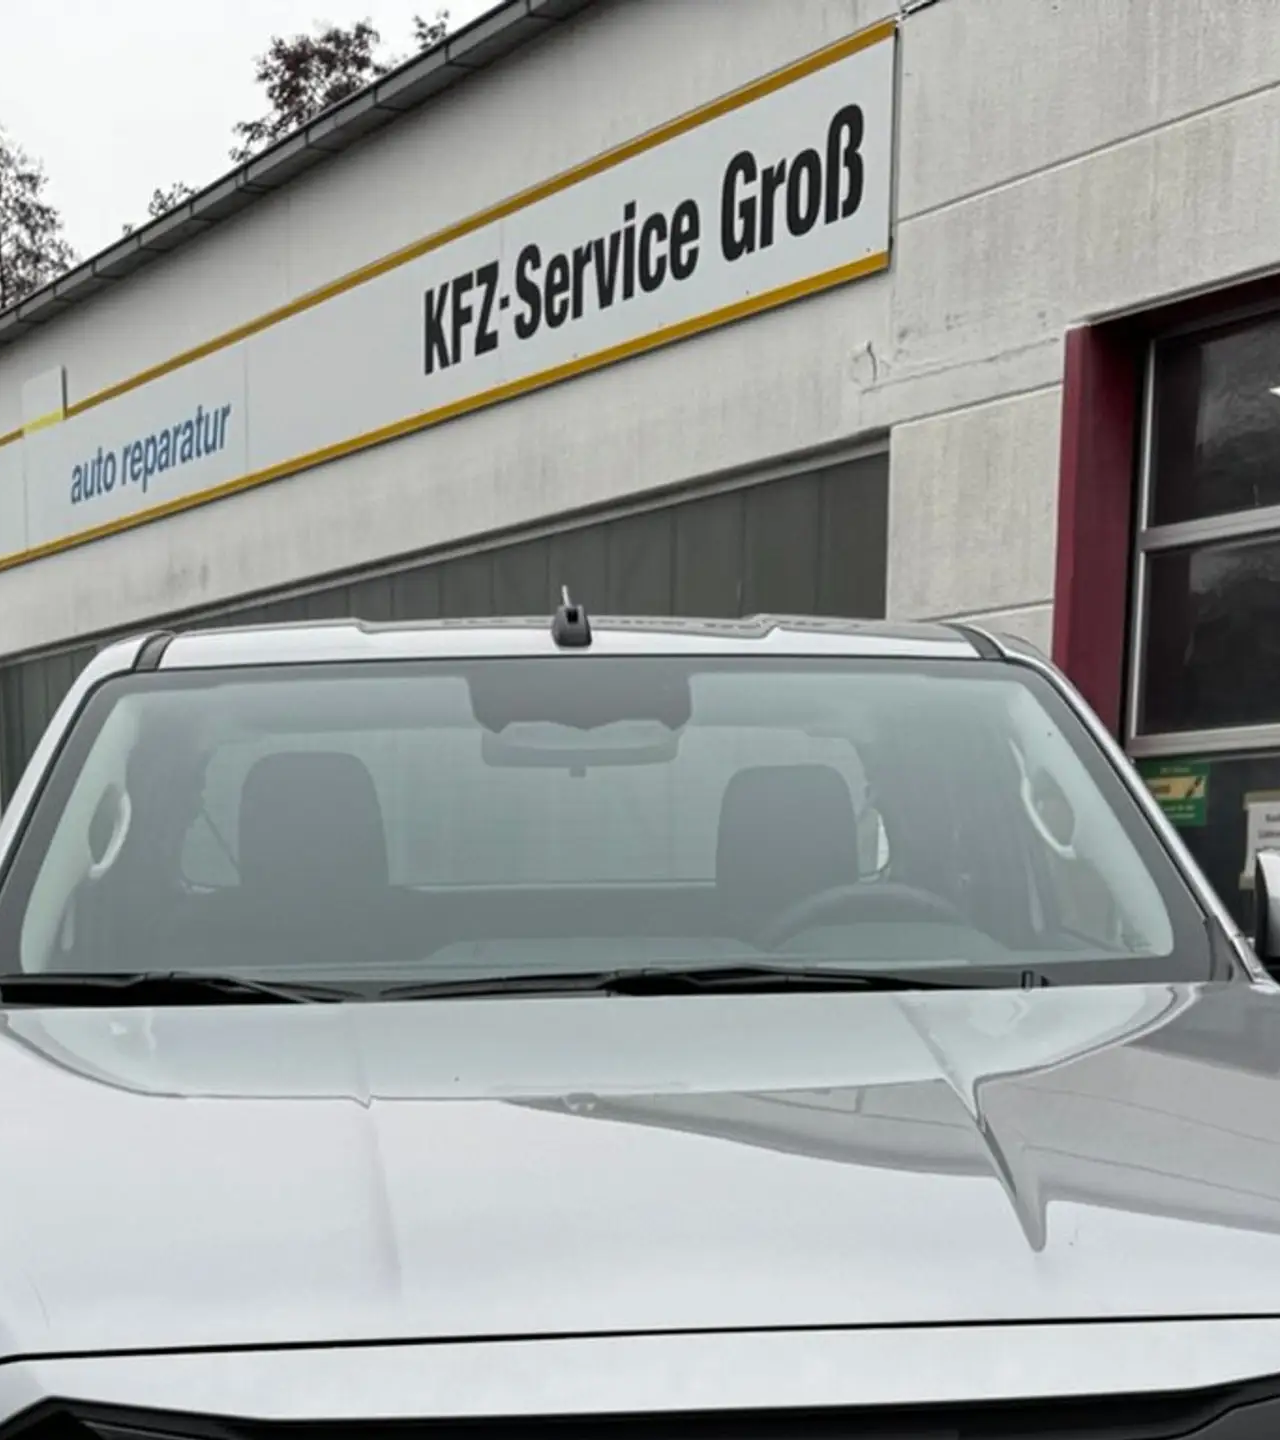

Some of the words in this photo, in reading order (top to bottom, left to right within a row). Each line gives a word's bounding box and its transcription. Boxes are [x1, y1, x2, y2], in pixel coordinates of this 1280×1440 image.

[423, 199, 700, 376] KFZ-Service
[721, 104, 865, 262] Groß
[71, 445, 117, 504] auto
[121, 402, 231, 493] reparatur
